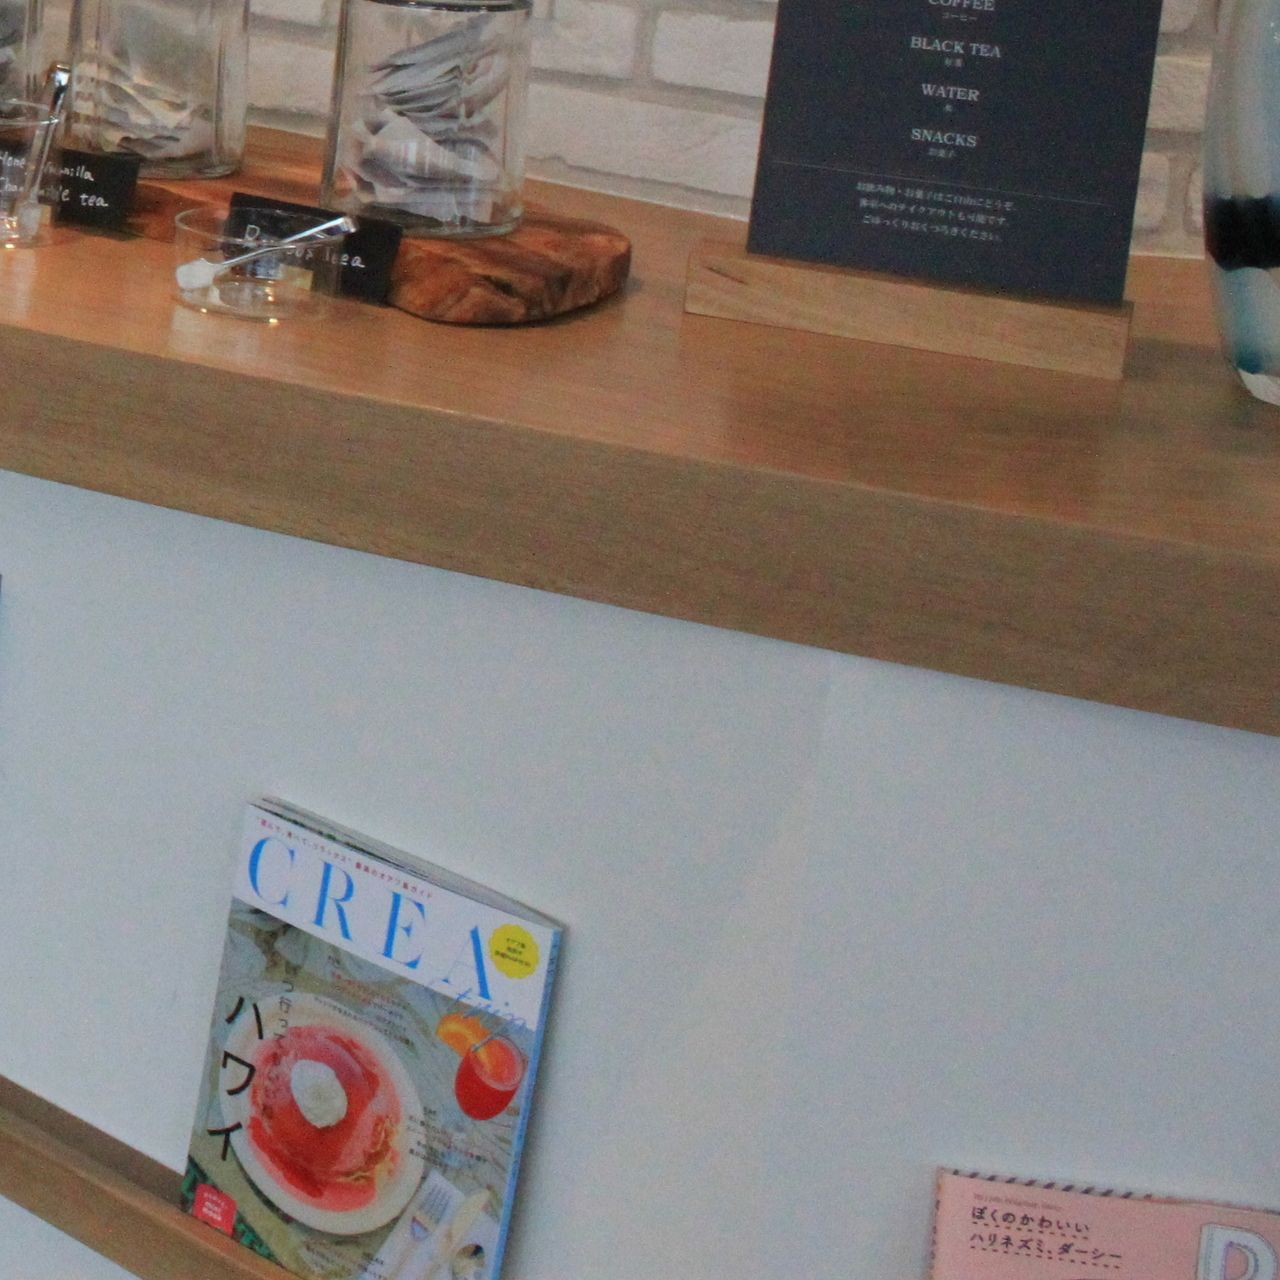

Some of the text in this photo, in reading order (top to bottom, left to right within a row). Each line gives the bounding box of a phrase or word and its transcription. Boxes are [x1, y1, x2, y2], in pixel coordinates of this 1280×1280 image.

[910, 35, 1002, 58] BLACK TEA
[921, 83, 980, 102] WATER
[911, 127, 978, 148] SNACKS
[79, 193, 110, 207] tea
[248, 834, 492, 1001] CREA
[207, 996, 264, 1161] ハワイ
[971, 1205, 1090, 1234] ぼくのかわいい
[970, 1232, 1122, 1261] ハリネズミ、ダーシー
